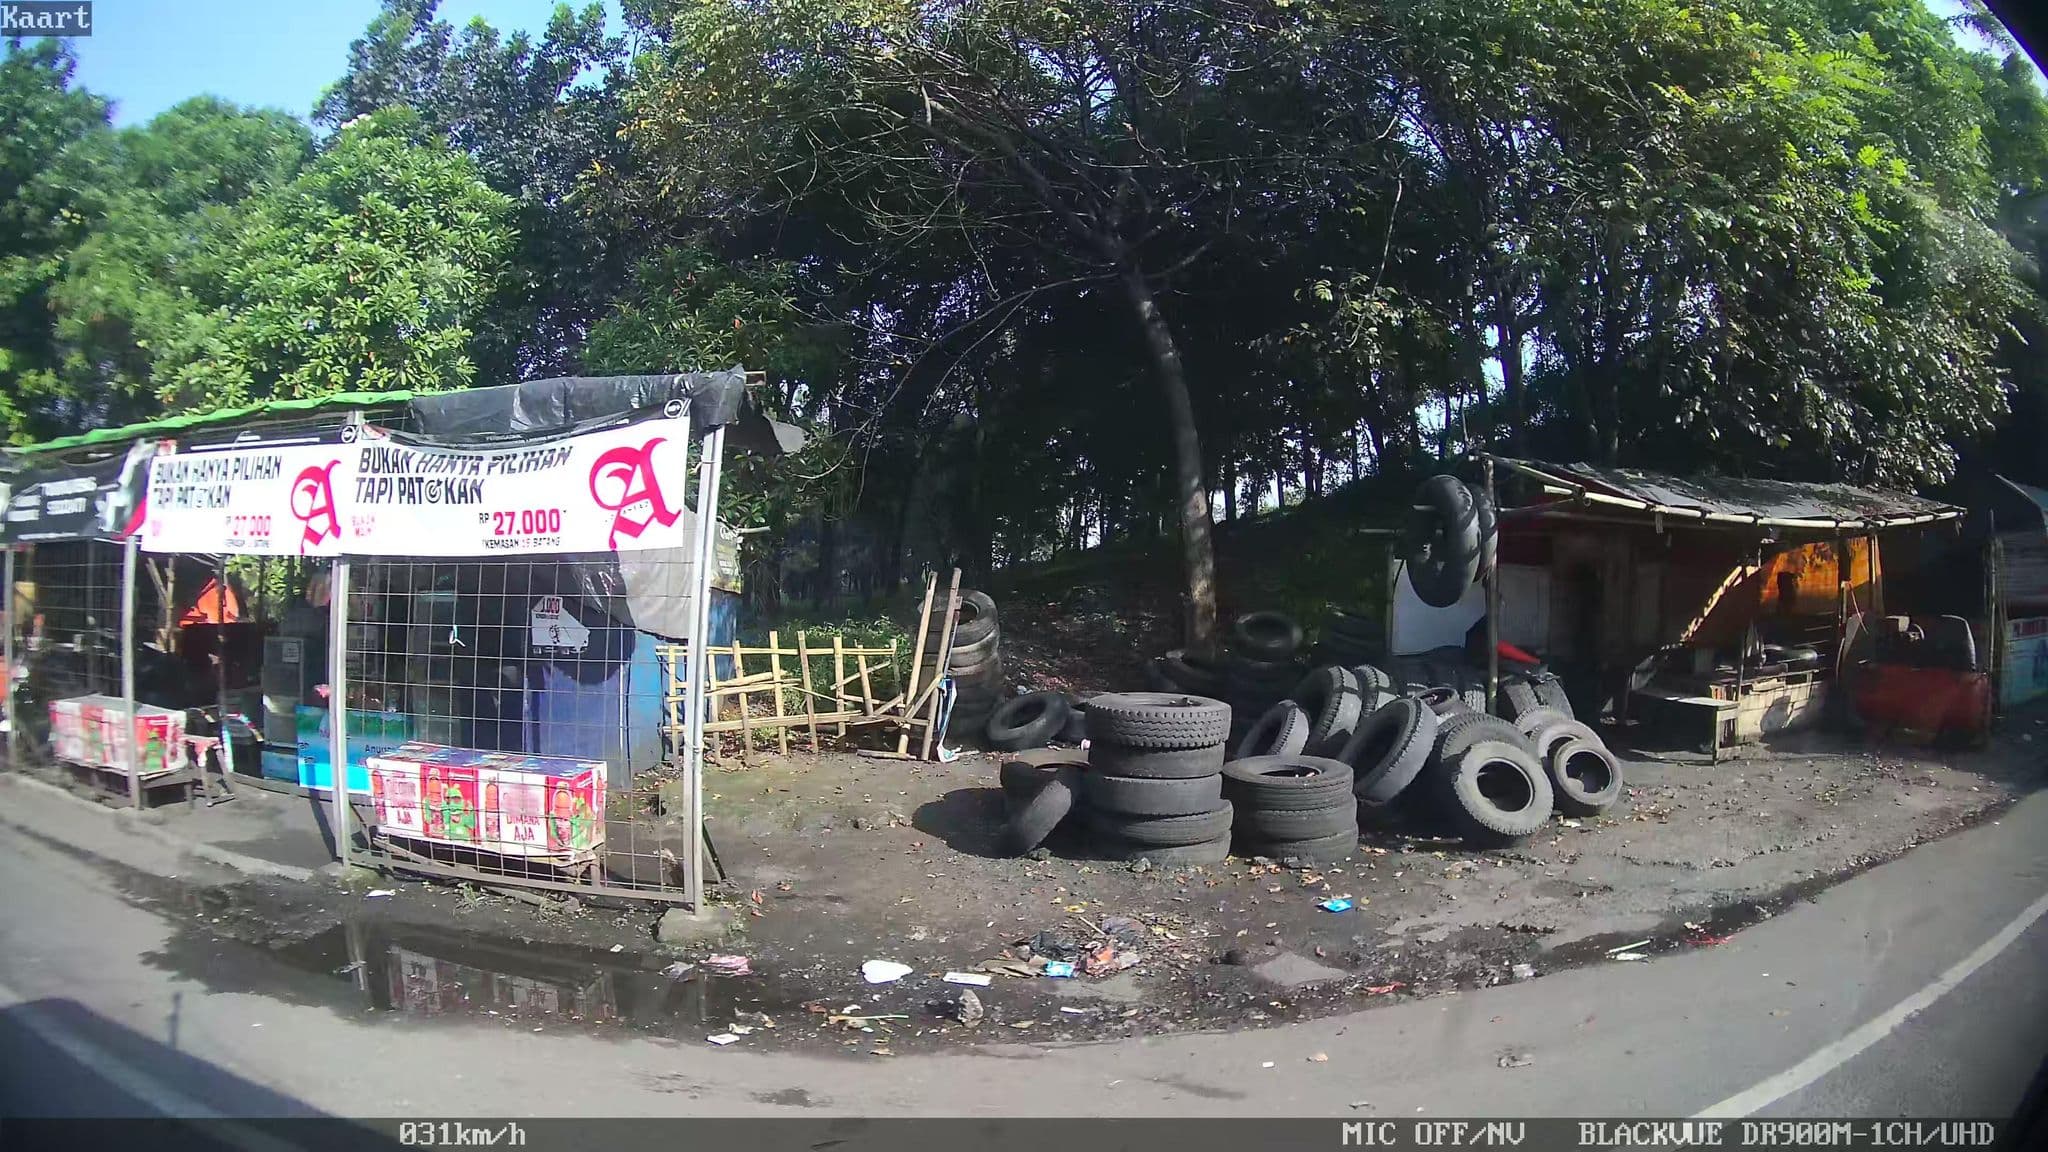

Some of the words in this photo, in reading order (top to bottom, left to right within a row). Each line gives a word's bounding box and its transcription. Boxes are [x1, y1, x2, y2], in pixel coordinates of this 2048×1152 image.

[232, 455, 282, 481] PILIHAN
[358, 447, 415, 474] BUKAN
[416, 454, 484, 475] HANYA
[487, 446, 573, 475] PILIHAN
[355, 477, 393, 504] TAPI
[514, 826, 535, 841] AJA
